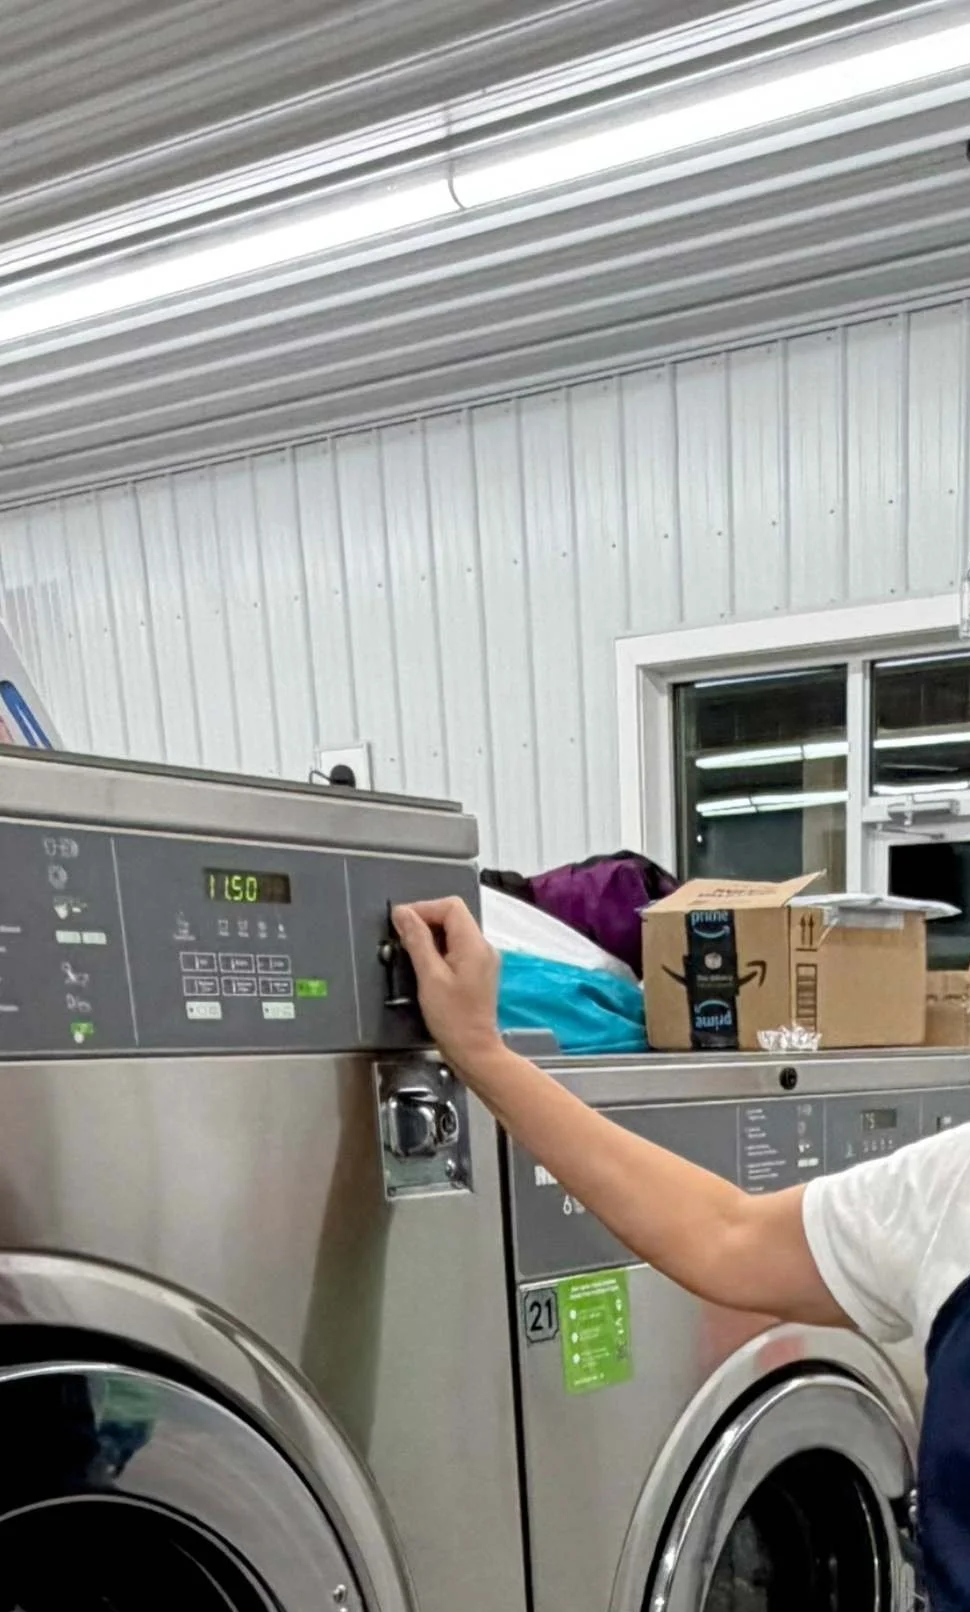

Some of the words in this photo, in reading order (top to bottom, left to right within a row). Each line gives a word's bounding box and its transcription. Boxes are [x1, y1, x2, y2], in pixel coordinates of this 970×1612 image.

[691, 910, 729, 926] prime
[695, 1009, 732, 1031] prime
[529, 1298, 553, 1332] 21
